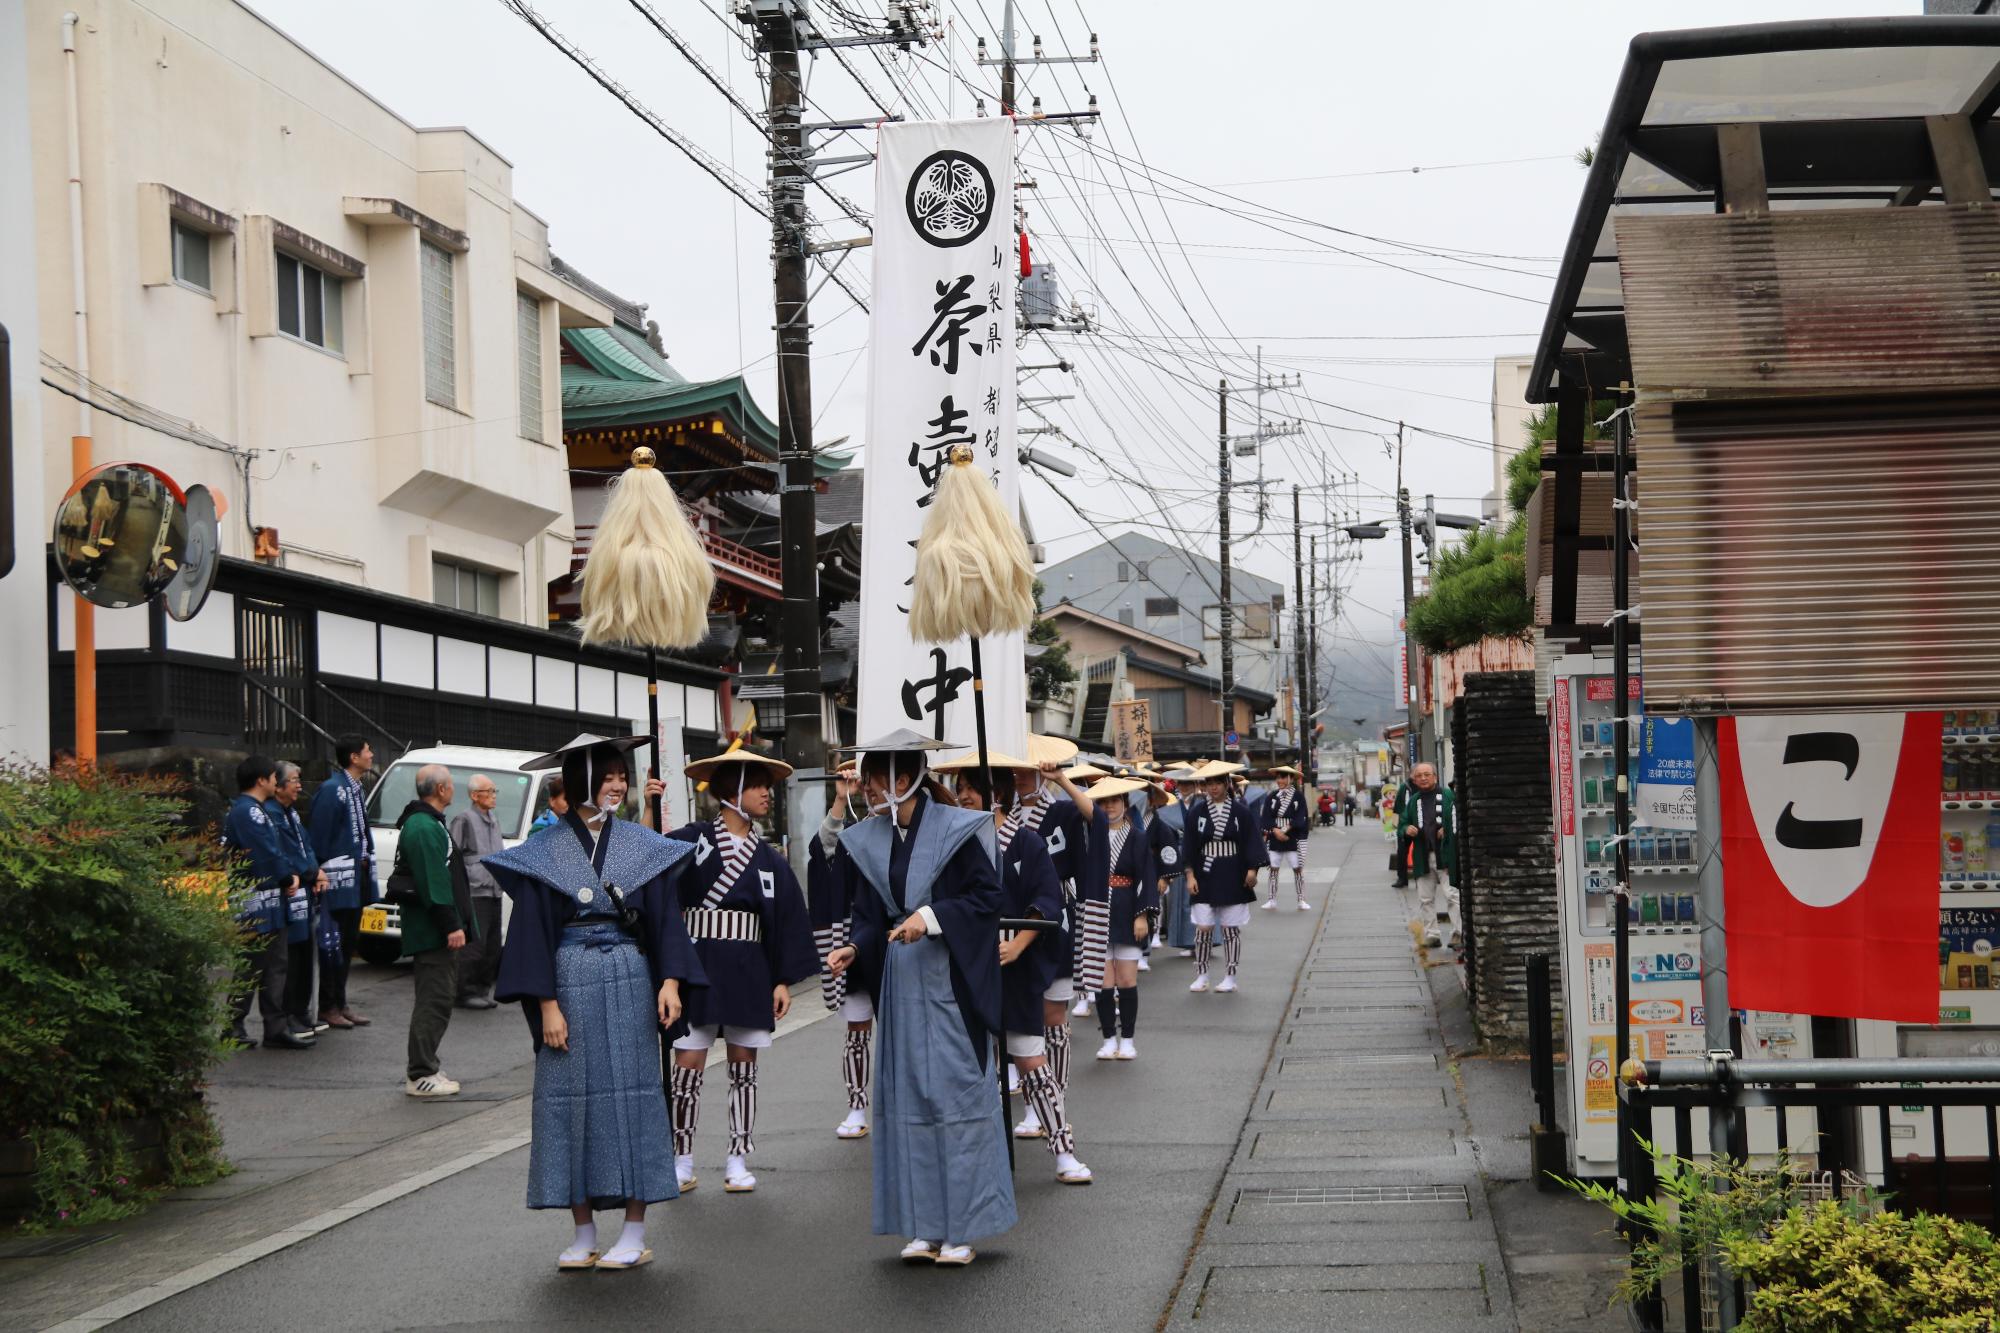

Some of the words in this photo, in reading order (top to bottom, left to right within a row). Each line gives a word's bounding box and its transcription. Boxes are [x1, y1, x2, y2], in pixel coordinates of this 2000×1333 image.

[898, 274, 987, 751] 茶壺中
[1775, 732, 1863, 849] こ
[1976, 943, 1990, 952] New
